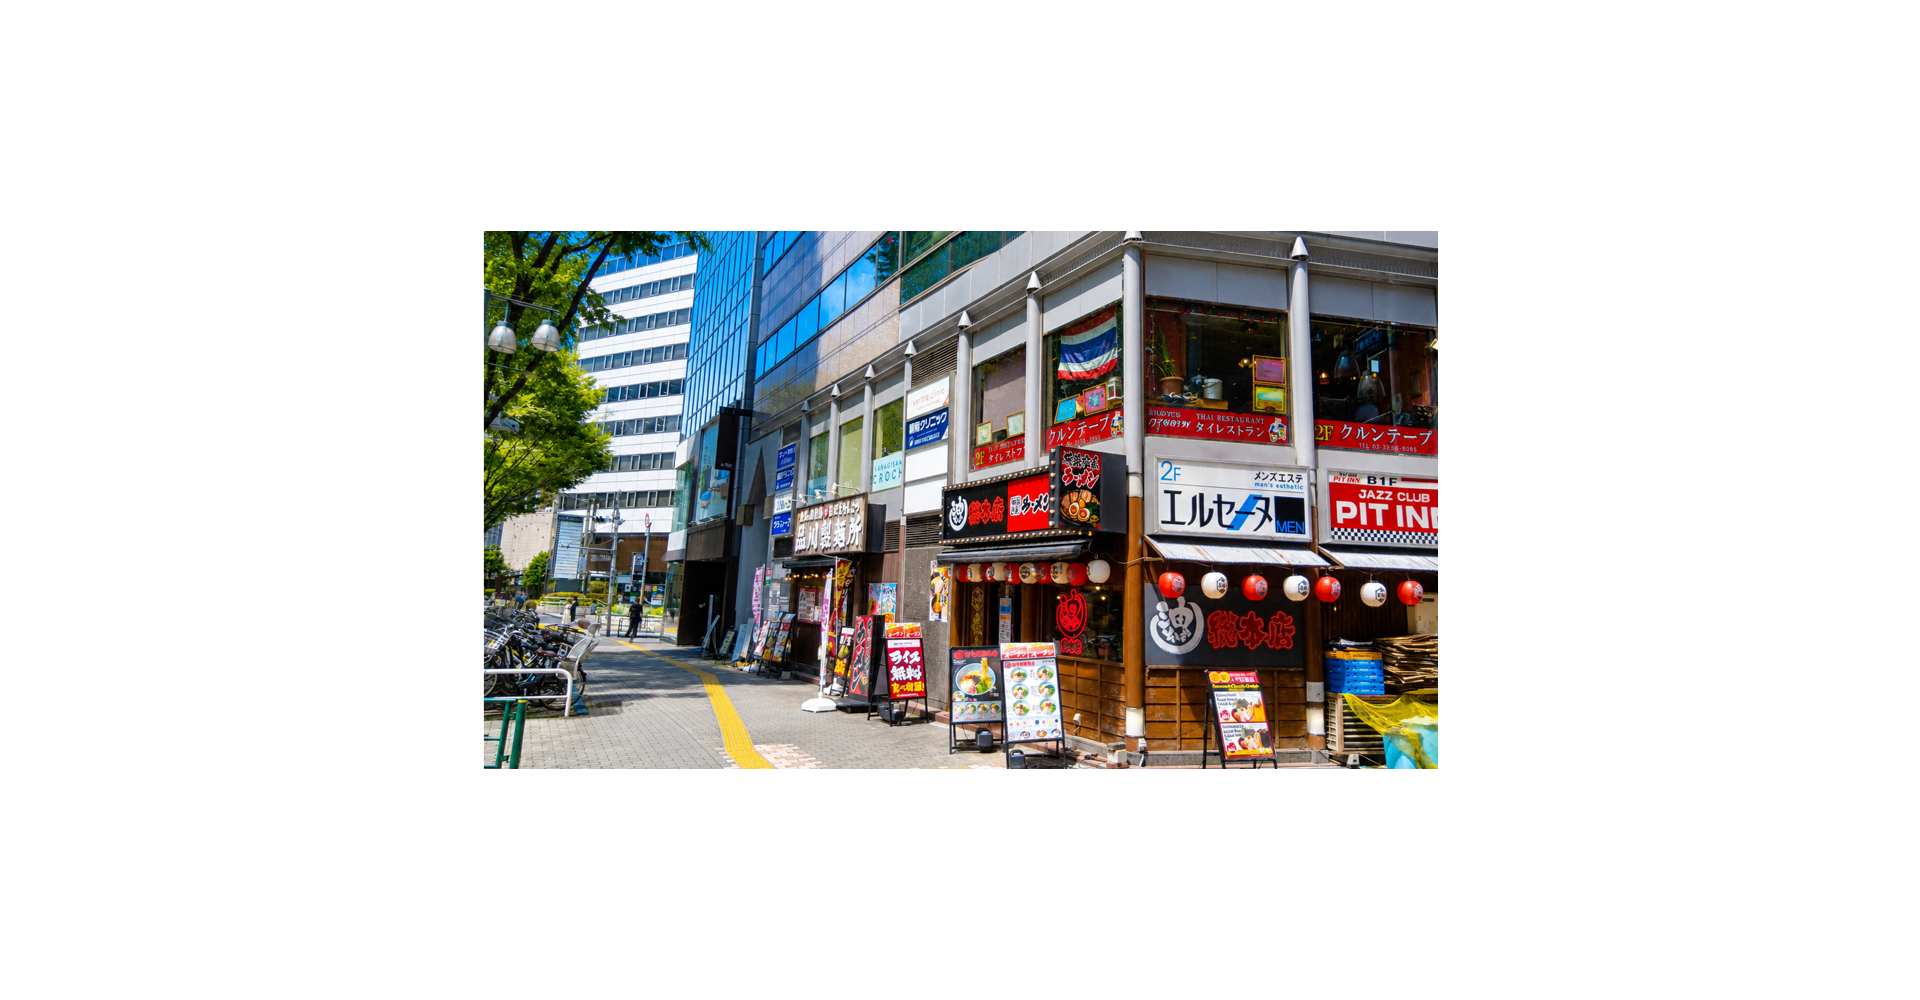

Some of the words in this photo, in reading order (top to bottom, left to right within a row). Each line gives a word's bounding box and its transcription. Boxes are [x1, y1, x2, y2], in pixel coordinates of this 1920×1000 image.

[1196, 413, 1214, 421] THAI
[1217, 414, 1265, 425] RESTAURANT
[1048, 414, 1110, 446] クルンテープ
[1195, 421, 1265, 438] タイレストラン
[1314, 424, 1334, 441] 2F
[1340, 423, 1433, 446] クルンテープ
[975, 450, 986, 466] 2F
[1062, 466, 1100, 489] ラーメン
[1160, 460, 1181, 482] 2F
[1254, 471, 1303, 484] メンズエステ
[1367, 475, 1397, 486] B1F
[1358, 489, 1393, 501] JAZZ
[1397, 492, 1430, 503] CLUB
[968, 496, 1005, 526] 総本店
[1161, 489, 1273, 532] エルセーヌ
[1336, 500, 1389, 526] PIT
[1276, 520, 1305, 534] MEN
[1206, 609, 1296, 650] 総本店
[888, 649, 921, 665] ライス
[890, 665, 922, 681] 無料
